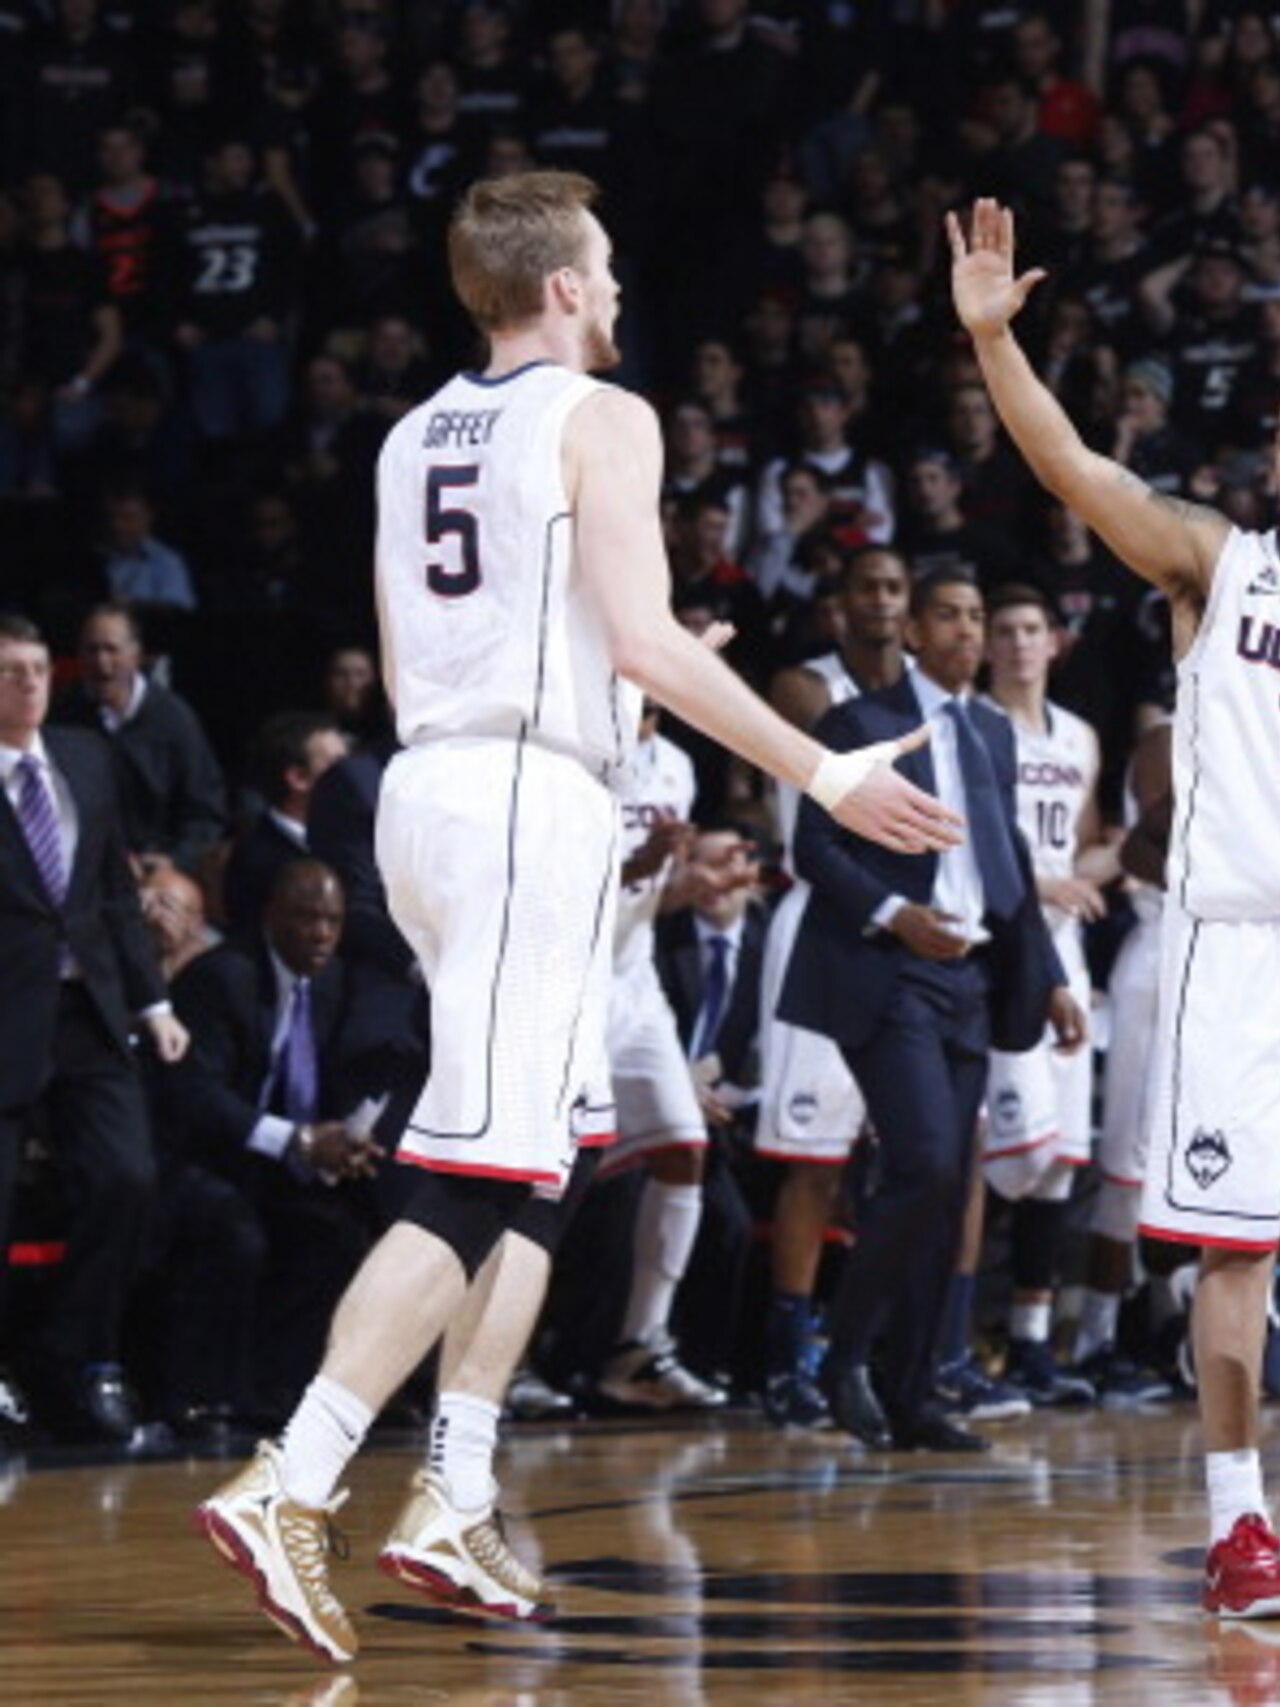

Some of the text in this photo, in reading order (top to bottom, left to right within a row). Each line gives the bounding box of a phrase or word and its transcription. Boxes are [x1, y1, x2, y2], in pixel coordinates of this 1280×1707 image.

[194, 246, 260, 293] 23
[425, 464, 482, 599] 5
[1036, 800, 1068, 849] 10
